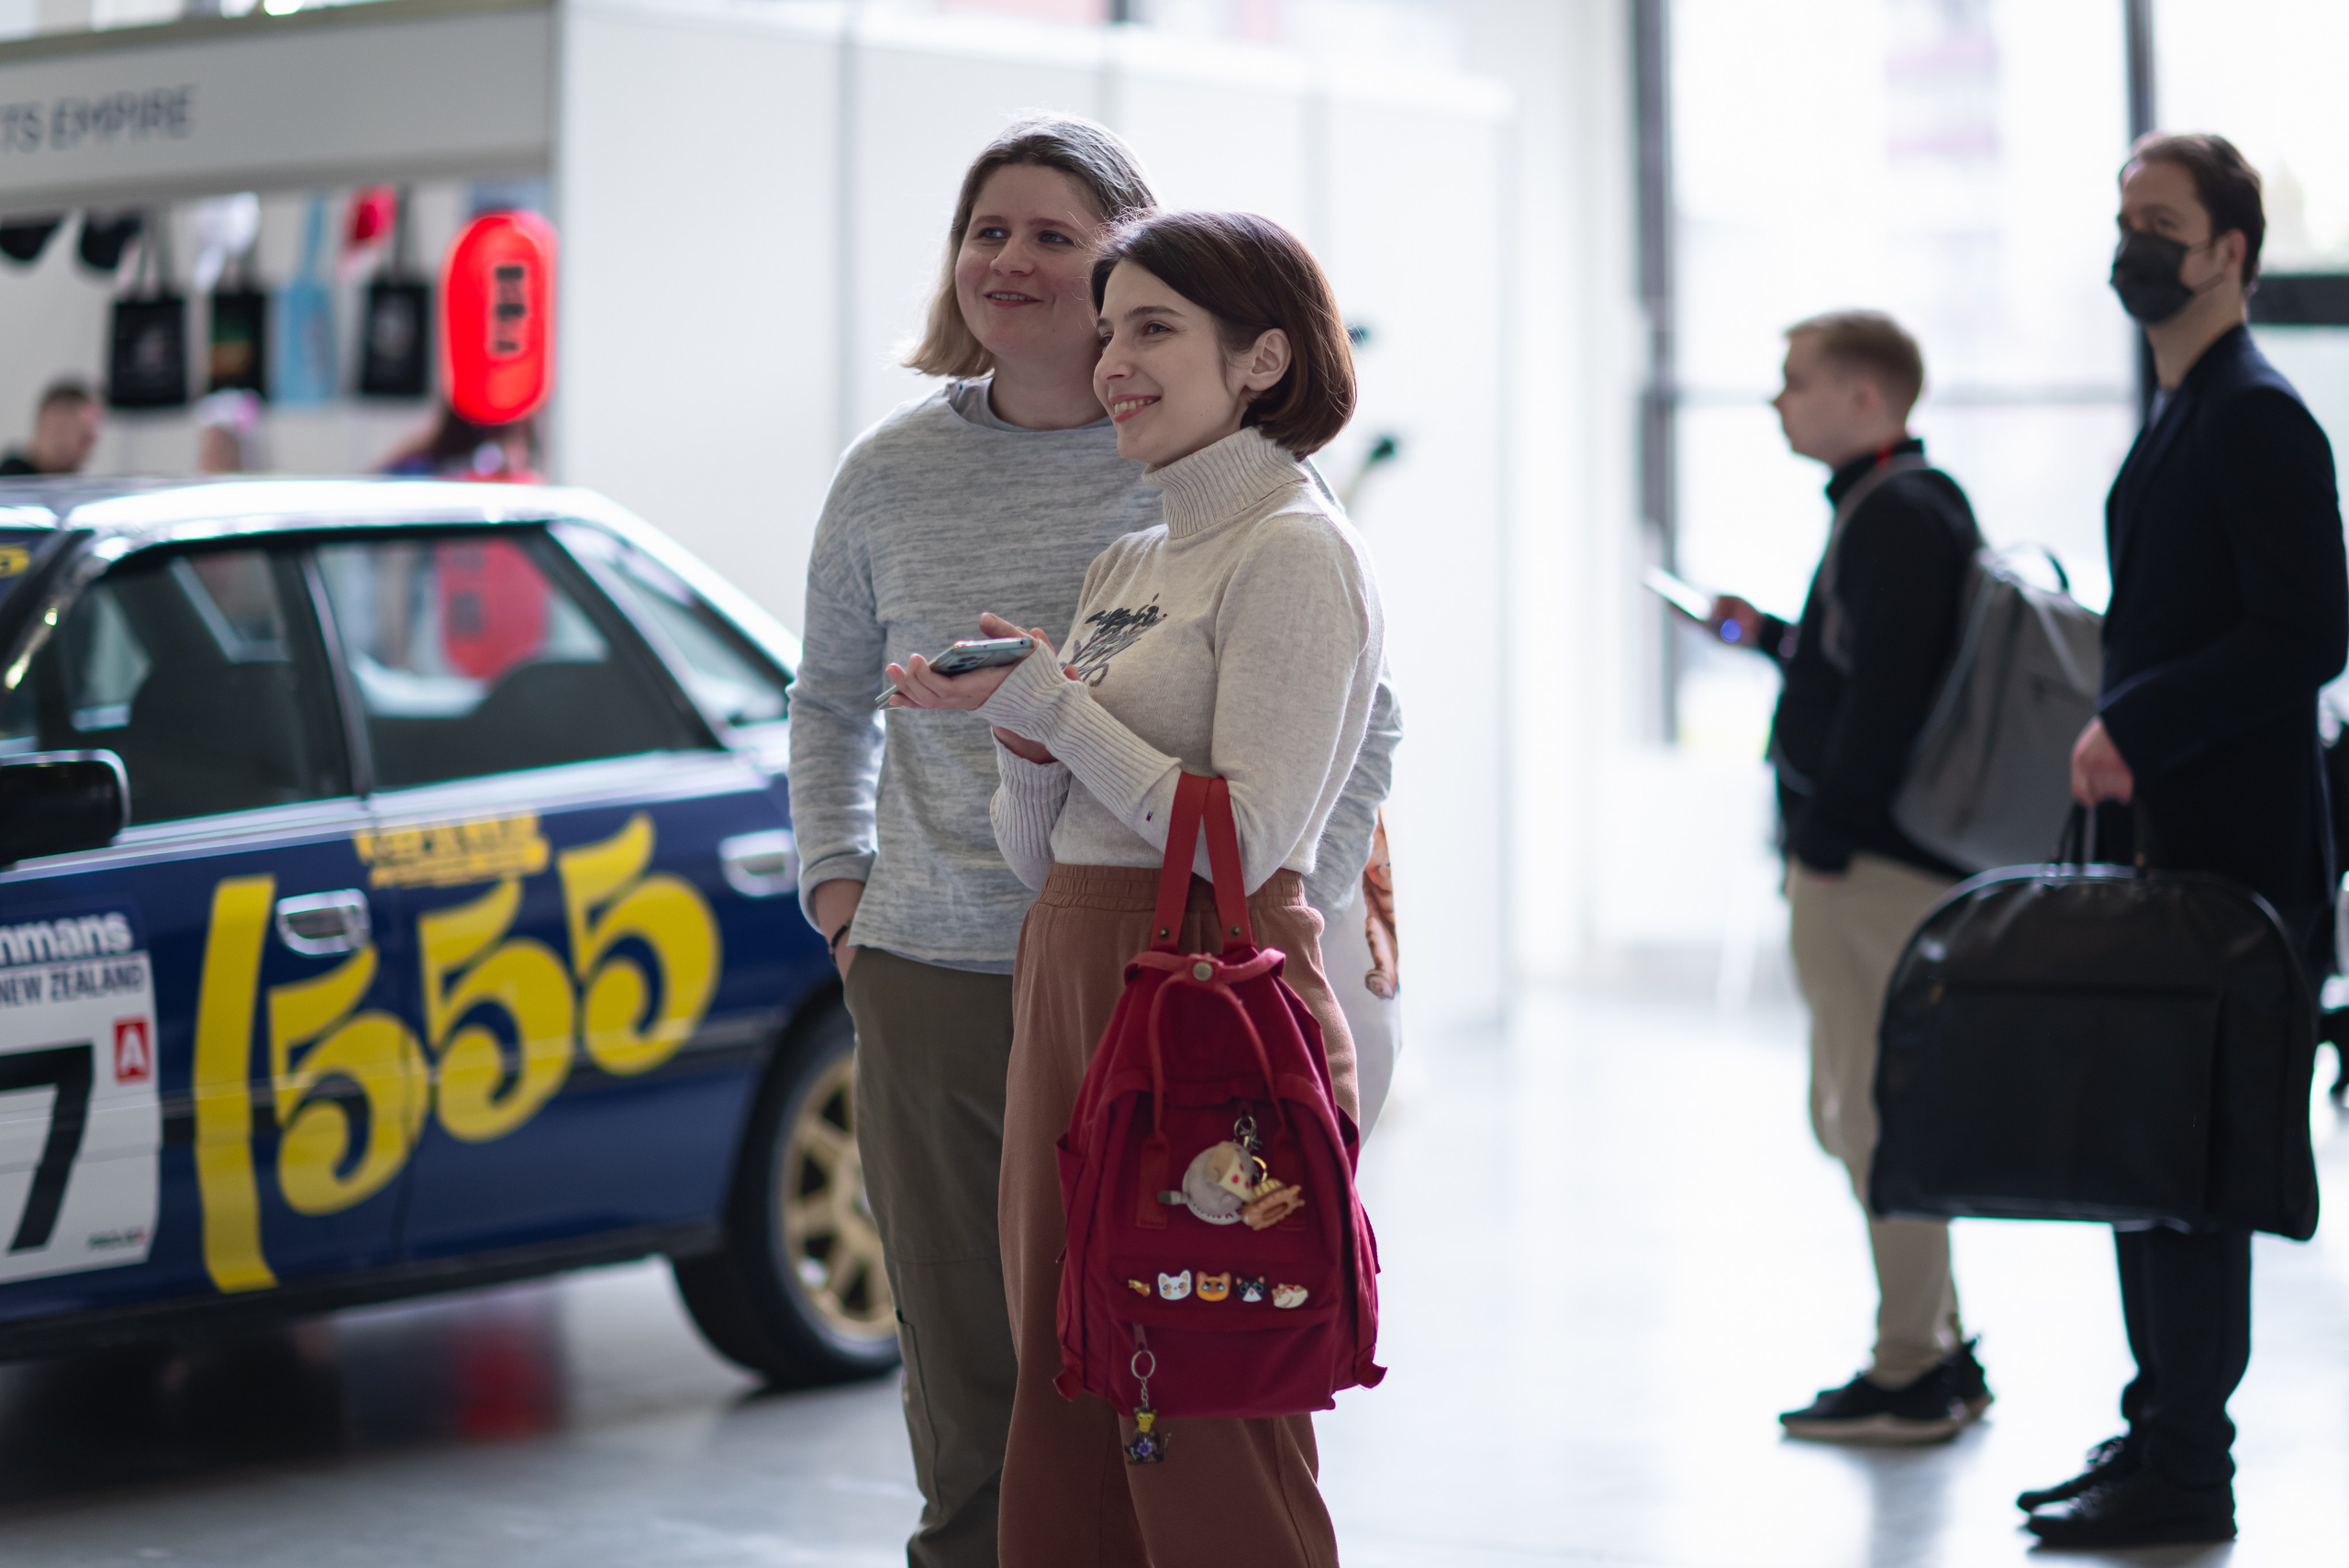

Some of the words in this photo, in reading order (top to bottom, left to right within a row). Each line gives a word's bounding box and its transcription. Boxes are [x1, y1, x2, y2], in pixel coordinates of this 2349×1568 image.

[51, 84, 194, 150] EMPIRE
[0, 974, 42, 1006] NEW
[50, 964, 144, 1002] ZEALAND
[117, 1023, 147, 1077] A
